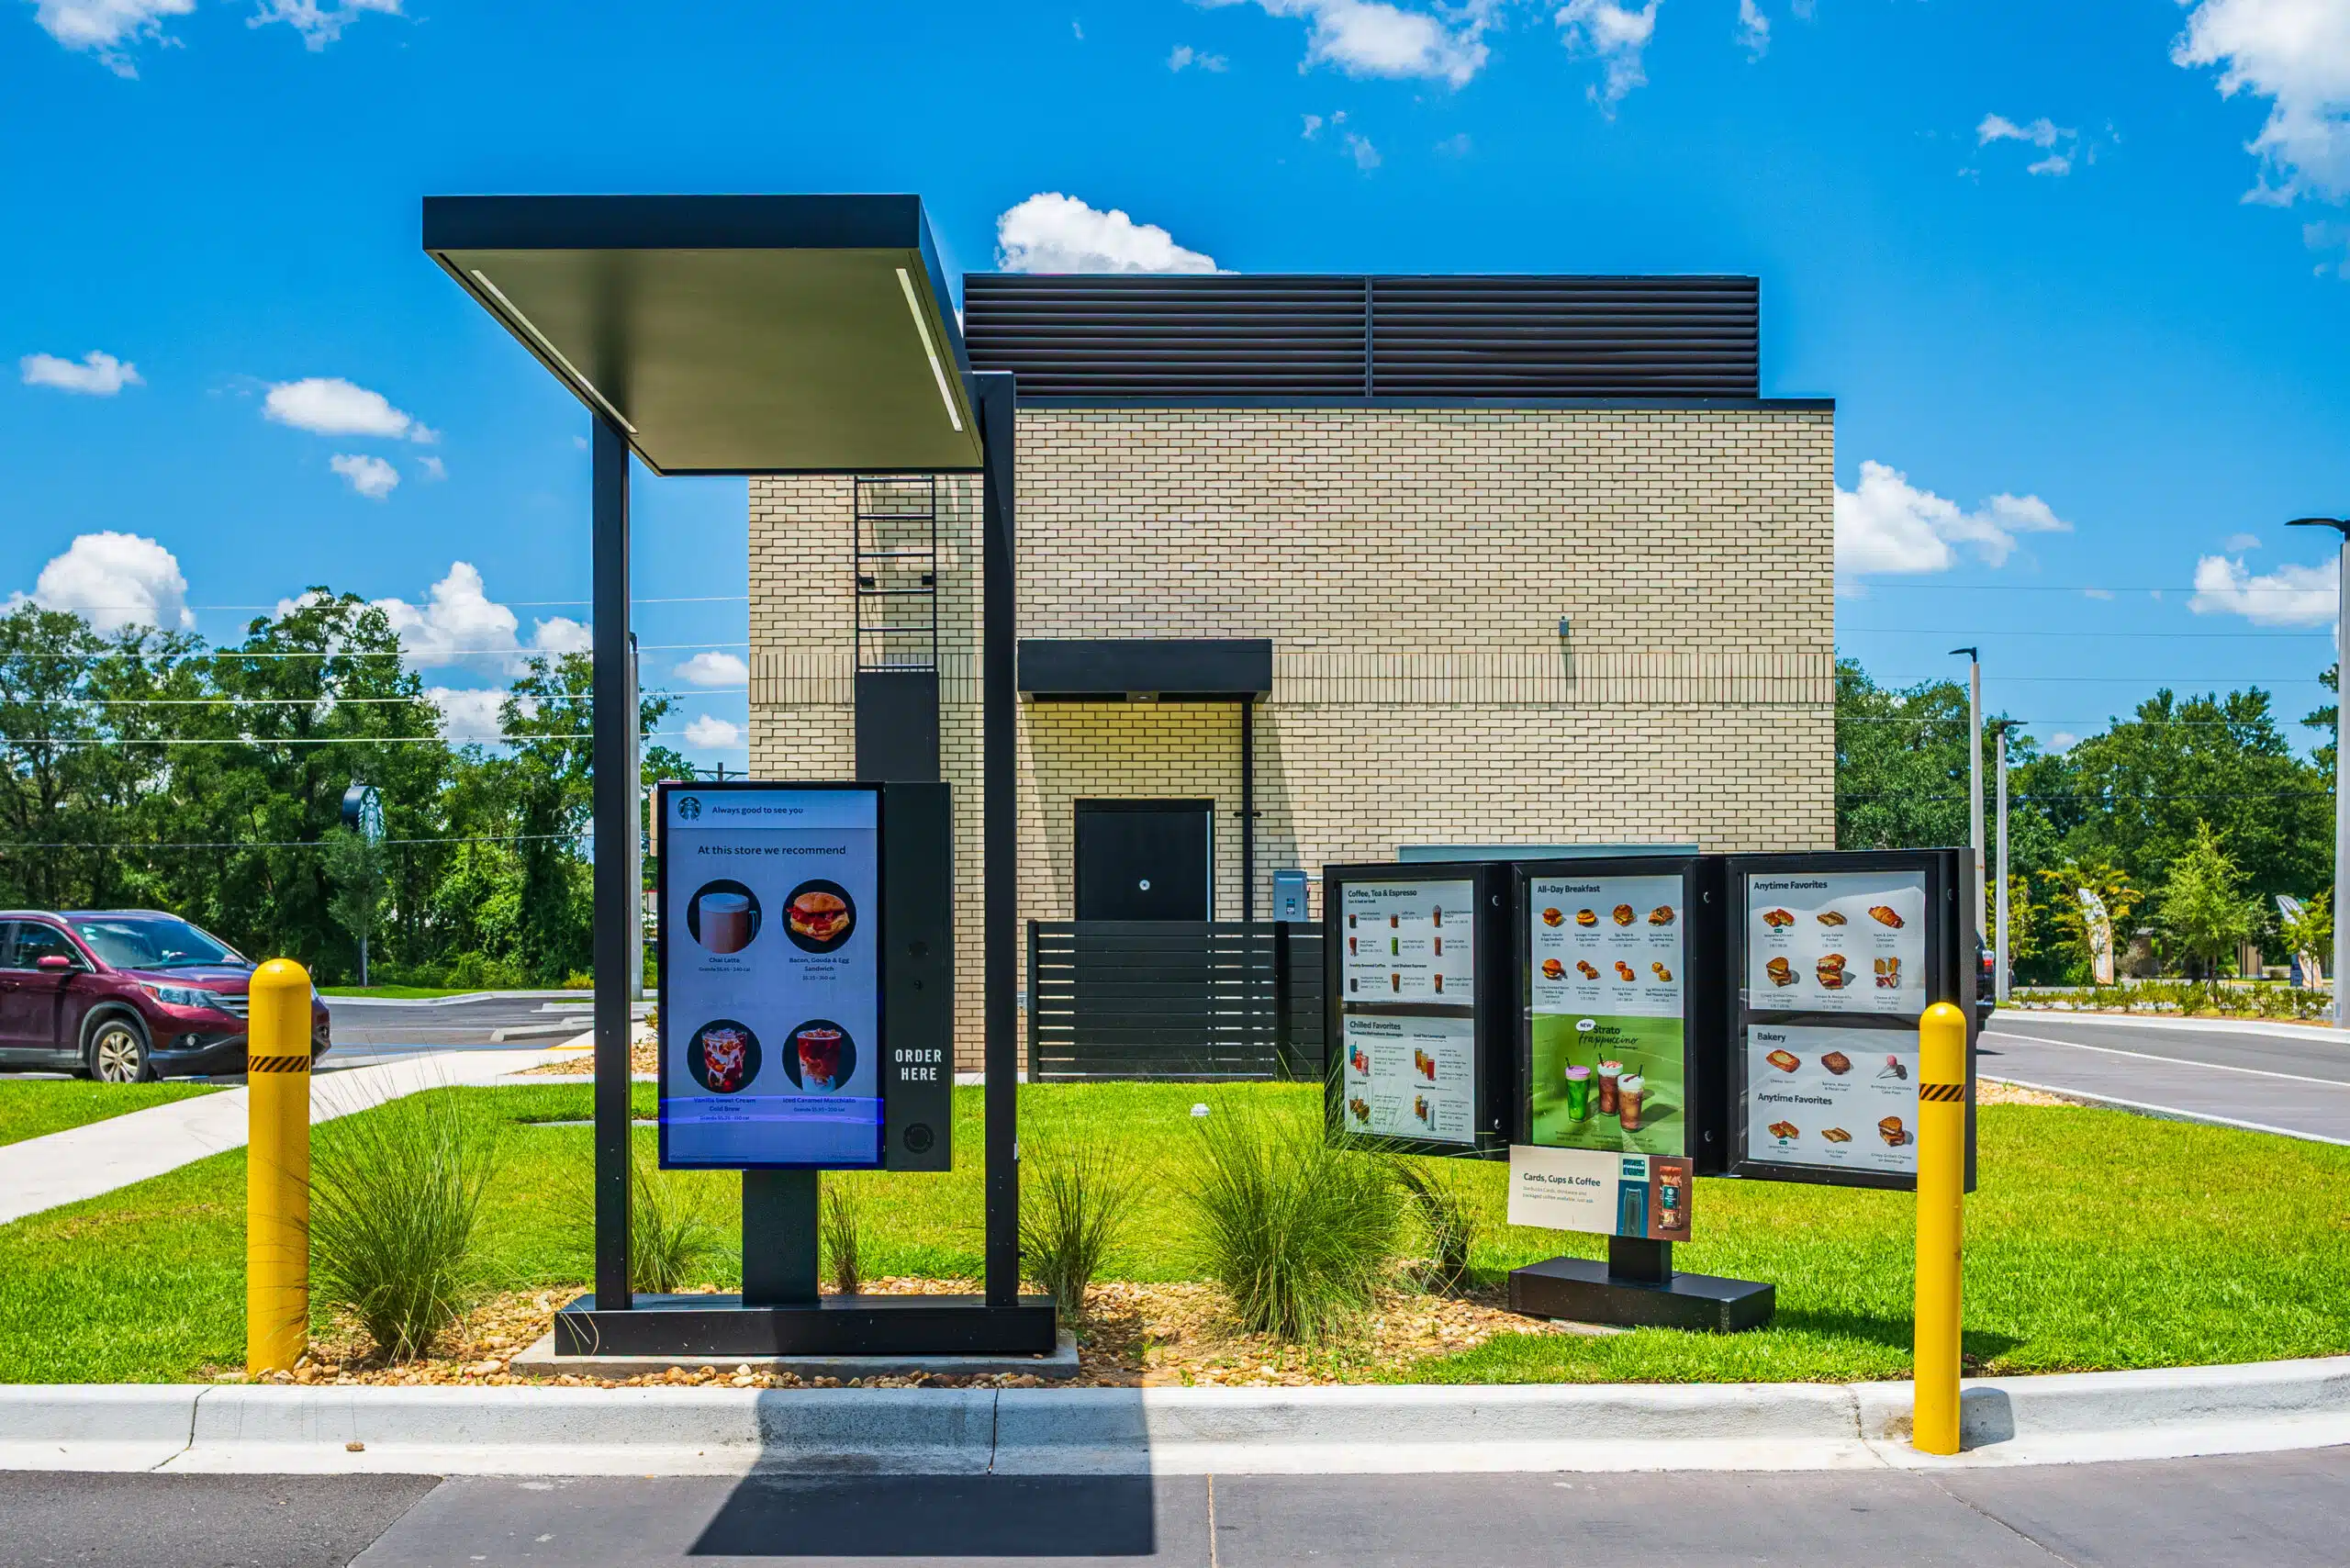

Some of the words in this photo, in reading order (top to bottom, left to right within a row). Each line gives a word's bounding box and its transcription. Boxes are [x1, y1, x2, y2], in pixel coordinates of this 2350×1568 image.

[712, 806, 740, 815] Always
[742, 807, 762, 815] good
[698, 846, 710, 855] At
[711, 846, 733, 855] this
[733, 846, 762, 855] store
[781, 846, 846, 855] recommend
[1538, 885, 1564, 894] All-Day
[1564, 884, 1601, 893] Breakfast
[1754, 880, 1789, 891] Anytime
[1790, 880, 1828, 890] Favorites
[1348, 890, 1371, 898] Coffee,
[1389, 889, 1417, 898] Espresso
[1349, 1021, 1371, 1029] Chilled
[1372, 1022, 1402, 1030] Favorites
[1593, 1025, 1621, 1035] Strato
[1579, 1030, 1639, 1048] Frappuccino
[1757, 1032, 1786, 1043] Bakery
[895, 1048, 942, 1062] ORDER
[901, 1068, 937, 1081] HERE
[1758, 1092, 1794, 1103] Anytime
[1795, 1094, 1833, 1105] Favorites
[1524, 1172, 1547, 1183] Cards,
[1548, 1174, 1567, 1185] Cups
[1568, 1176, 1574, 1184] &
[1575, 1177, 1601, 1187] Coffee
